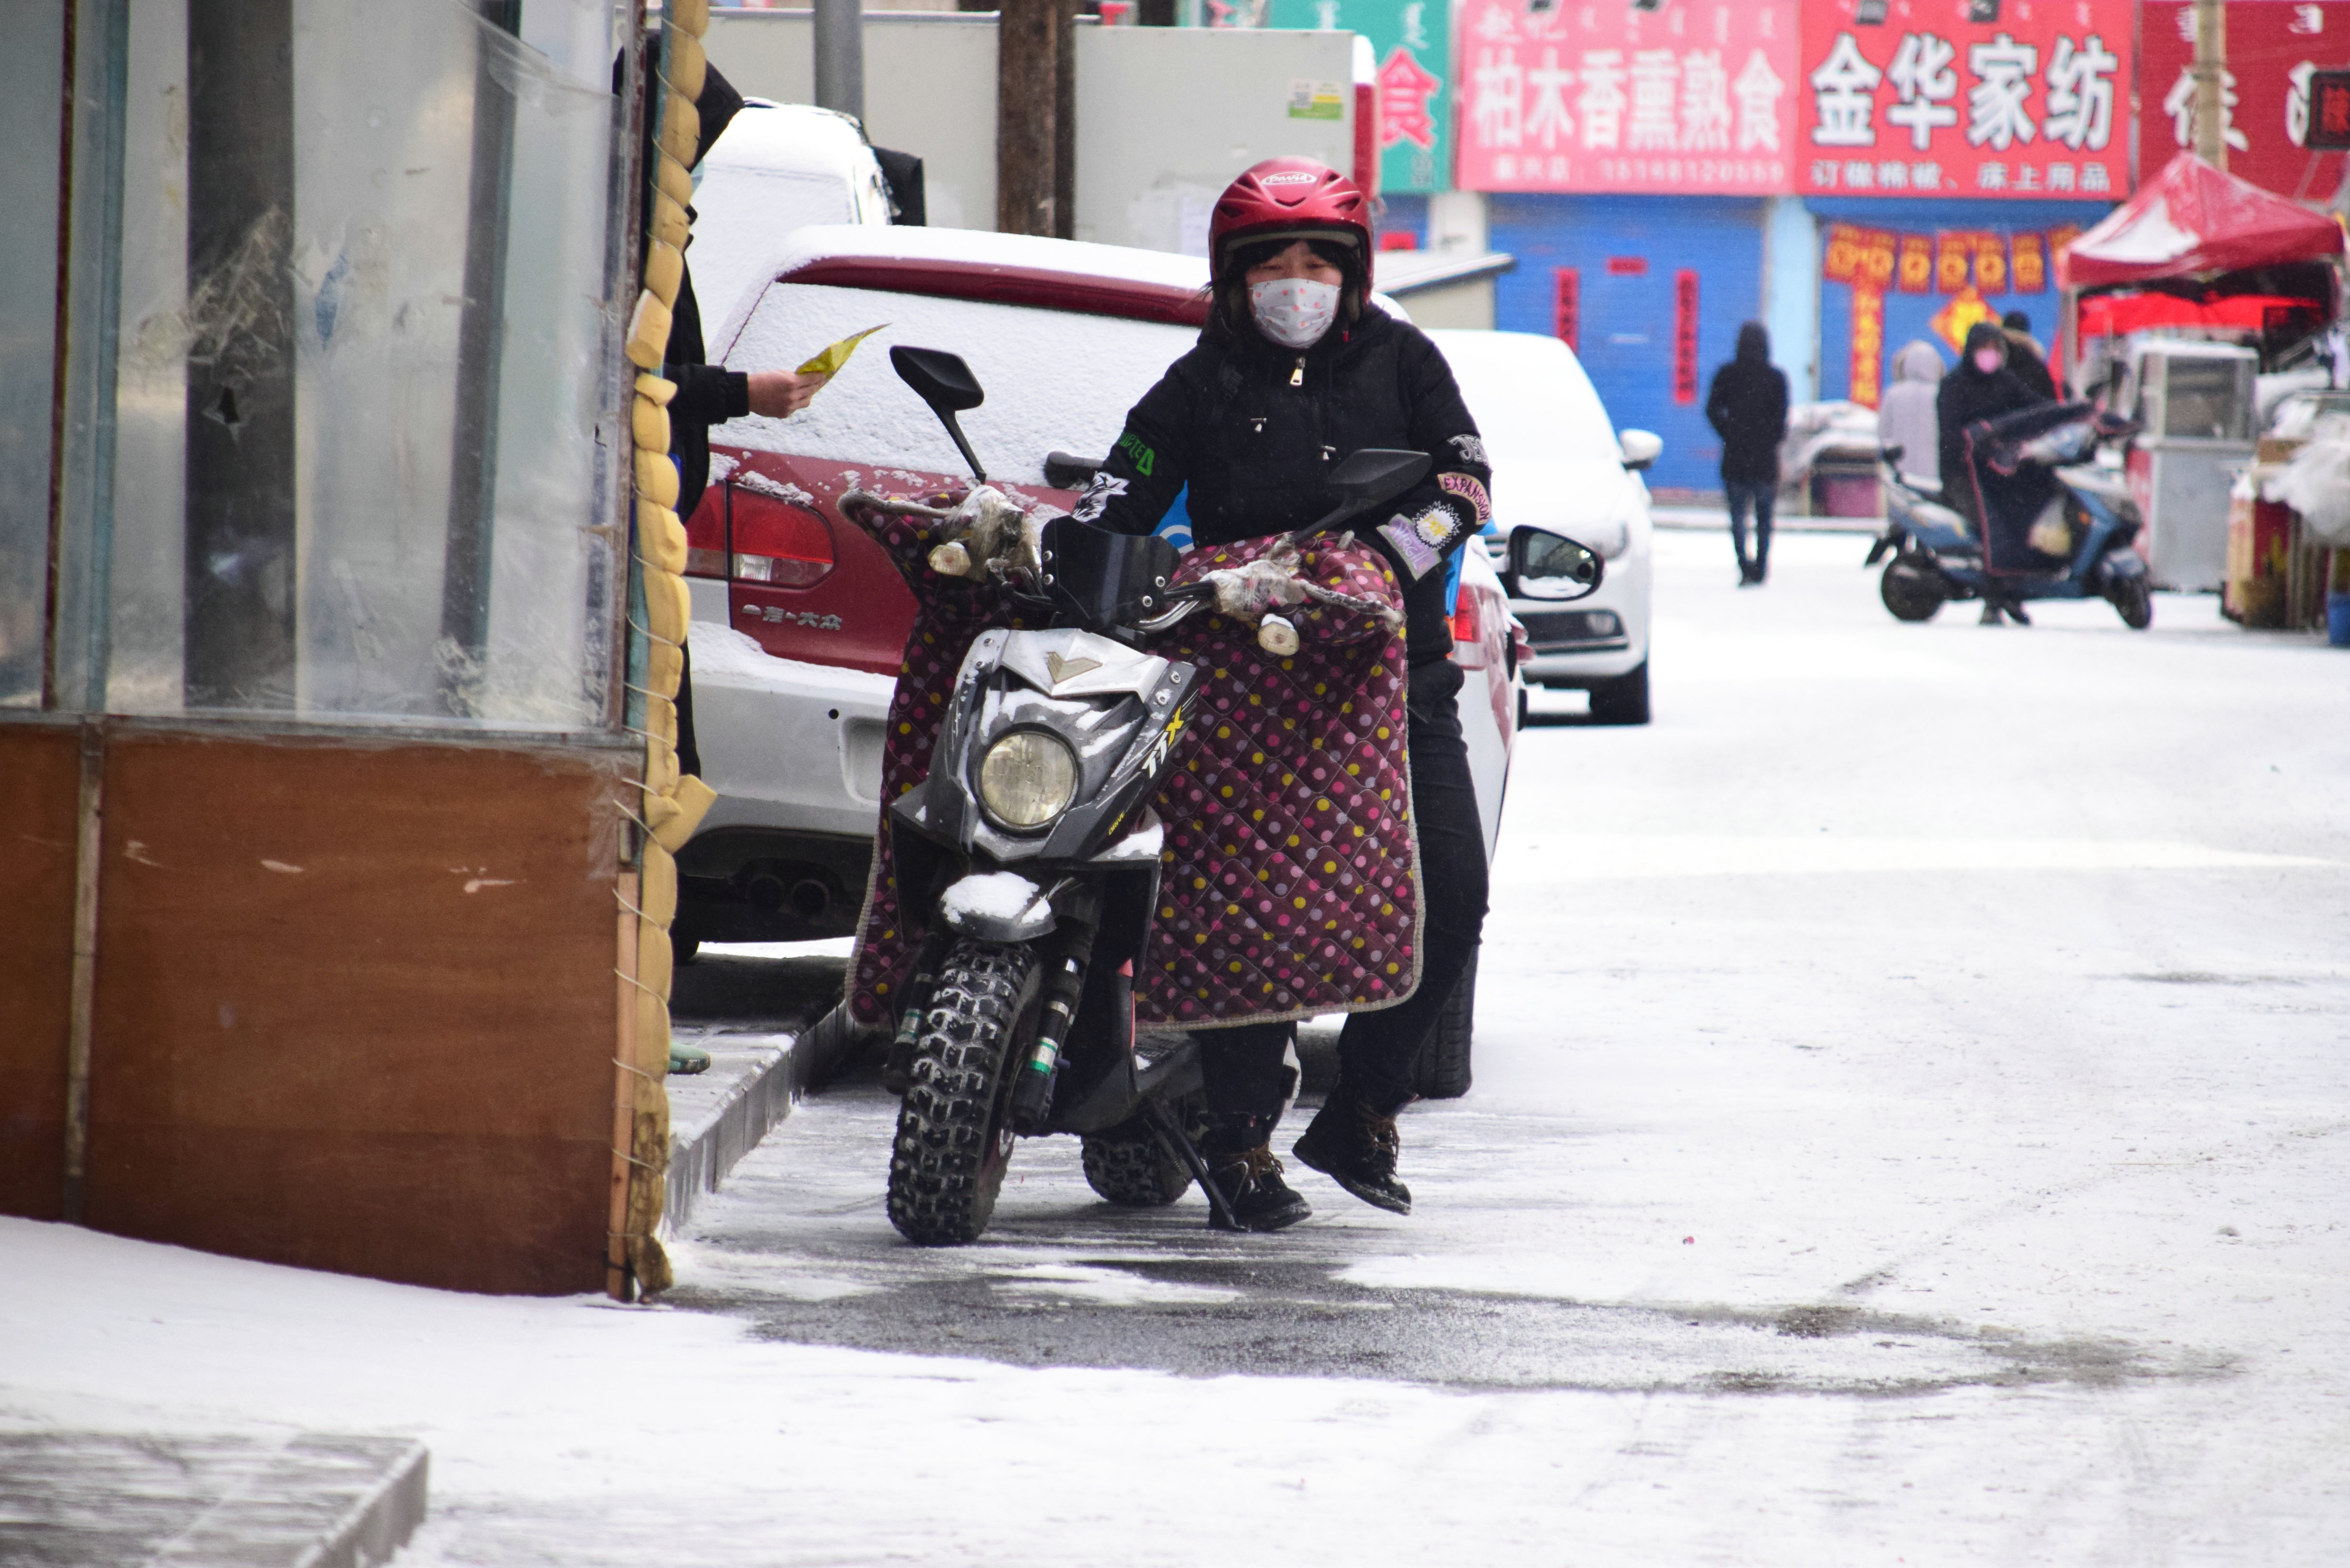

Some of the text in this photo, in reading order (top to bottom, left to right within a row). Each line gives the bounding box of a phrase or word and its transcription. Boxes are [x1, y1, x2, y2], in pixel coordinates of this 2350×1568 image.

[1808, 31, 2118, 151] 金华家纺
[1270, 174, 1308, 183] David
[1443, 475, 1490, 522] EXPANSION
